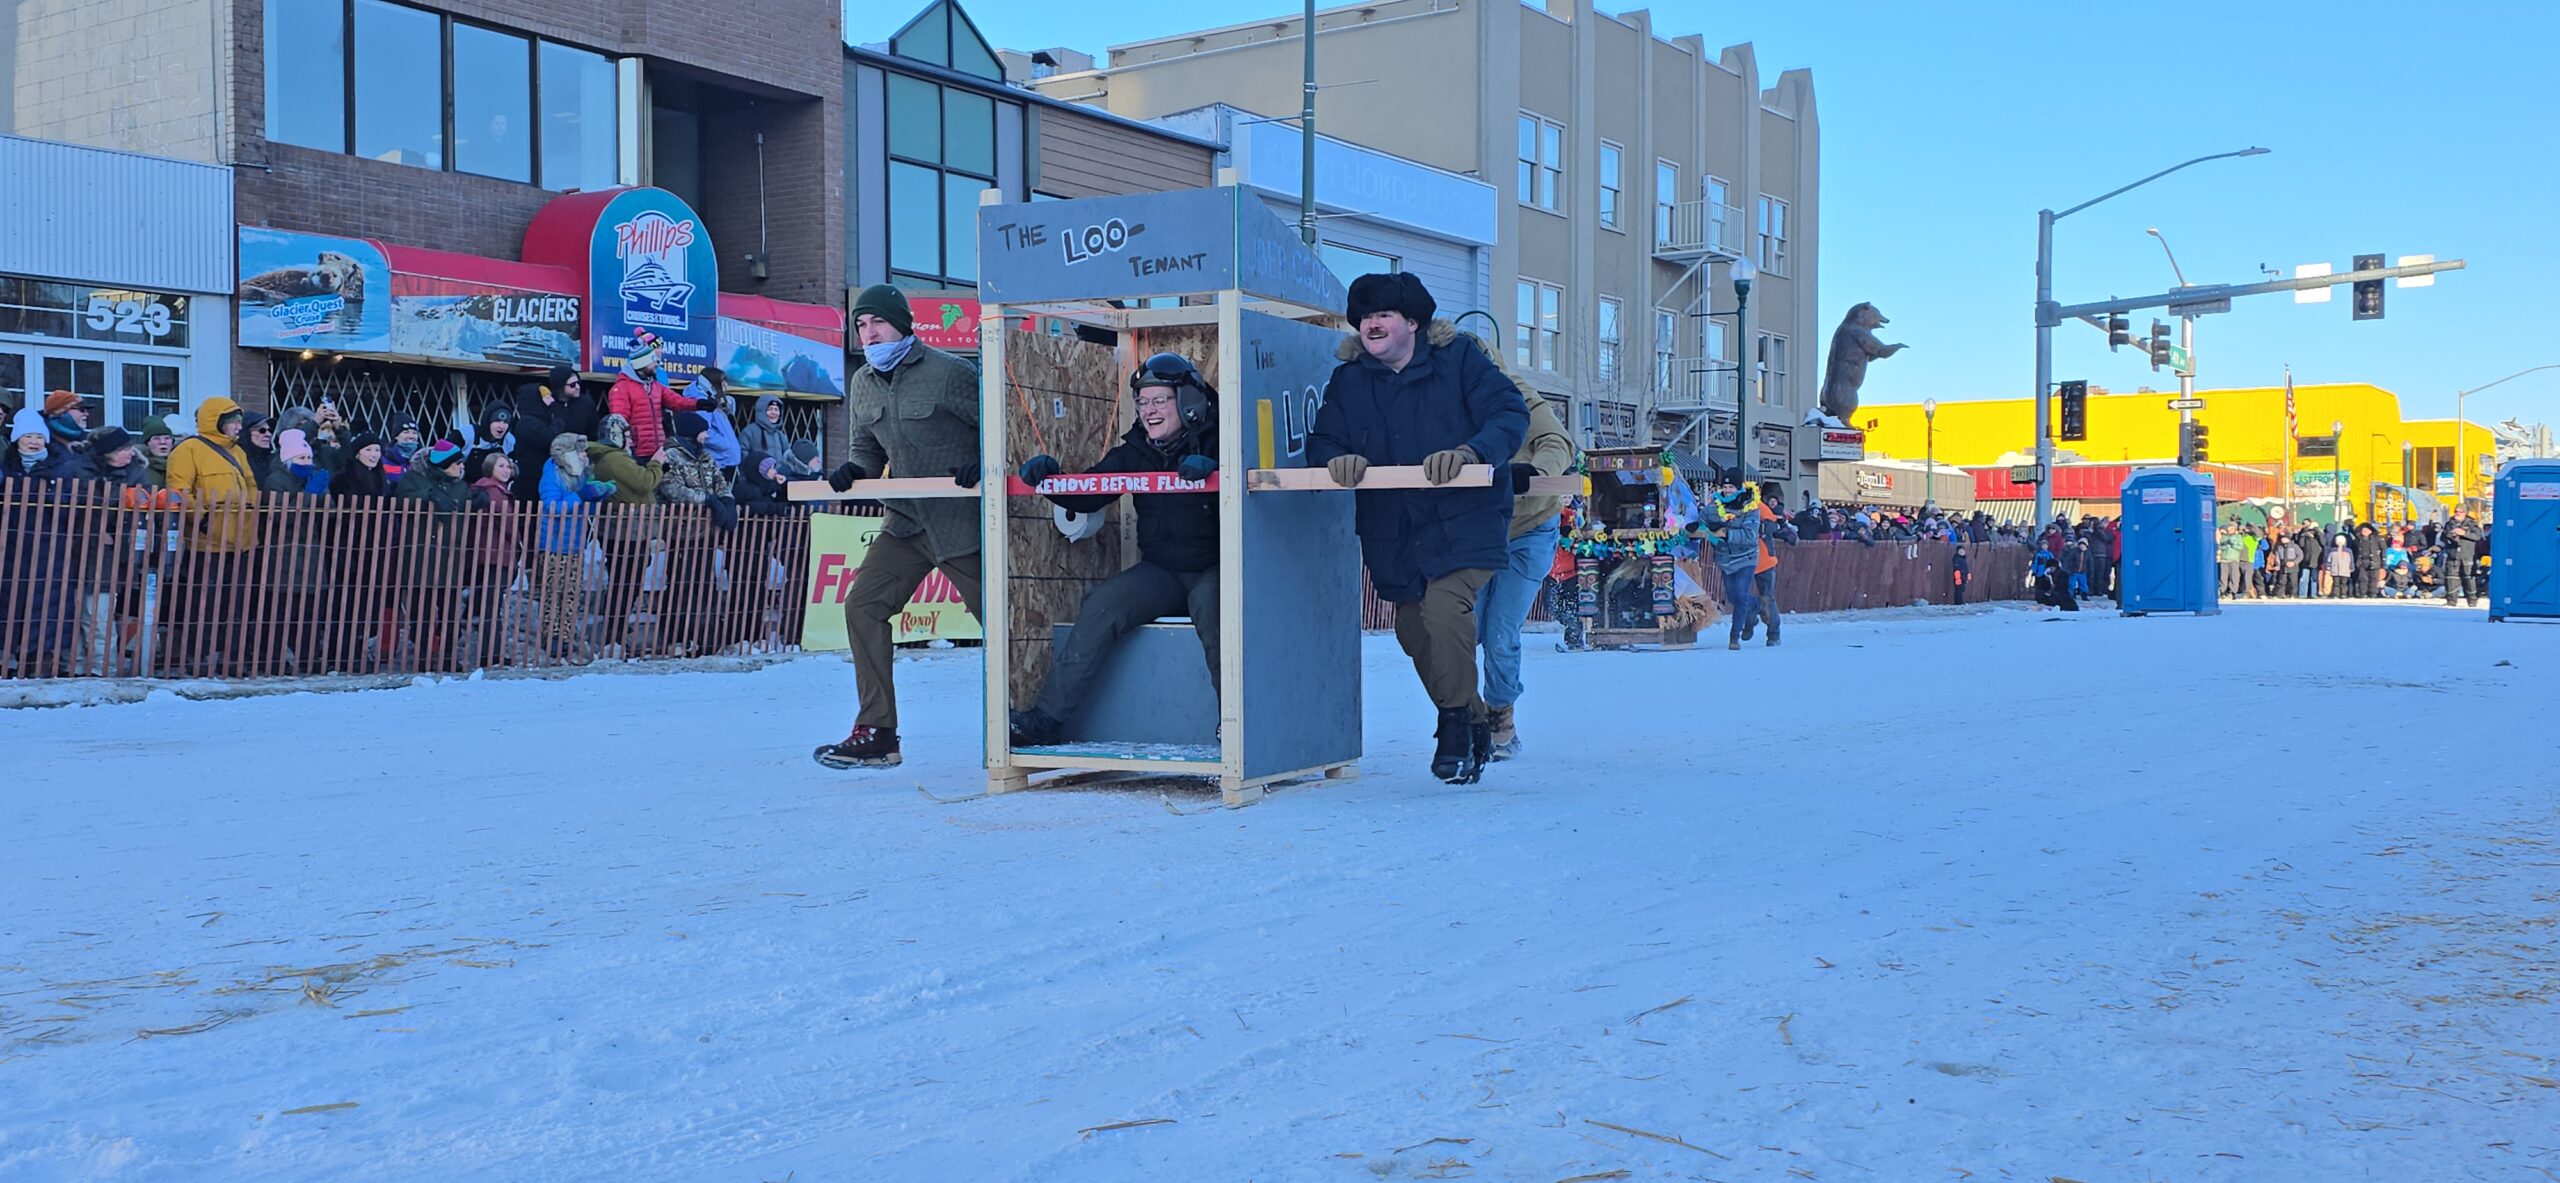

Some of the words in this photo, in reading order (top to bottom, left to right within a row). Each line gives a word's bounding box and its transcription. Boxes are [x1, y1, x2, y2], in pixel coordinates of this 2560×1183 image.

[614, 219, 695, 260] Phillips
[998, 222, 1047, 252] THE
[1128, 252, 1208, 278] TENANT
[86, 296, 172, 337] 523
[271, 303, 309, 318] Glacier
[311, 297, 343, 312] Quest
[493, 294, 579, 324] GLACIERS
[602, 335, 632, 351] PRINC
[677, 343, 707, 358] SOUND
[958, 336, 980, 344] TOU
[1250, 339, 1275, 370] THE
[1035, 477, 1098, 494] REMOVE
[1101, 475, 1150, 492] BEFORE
